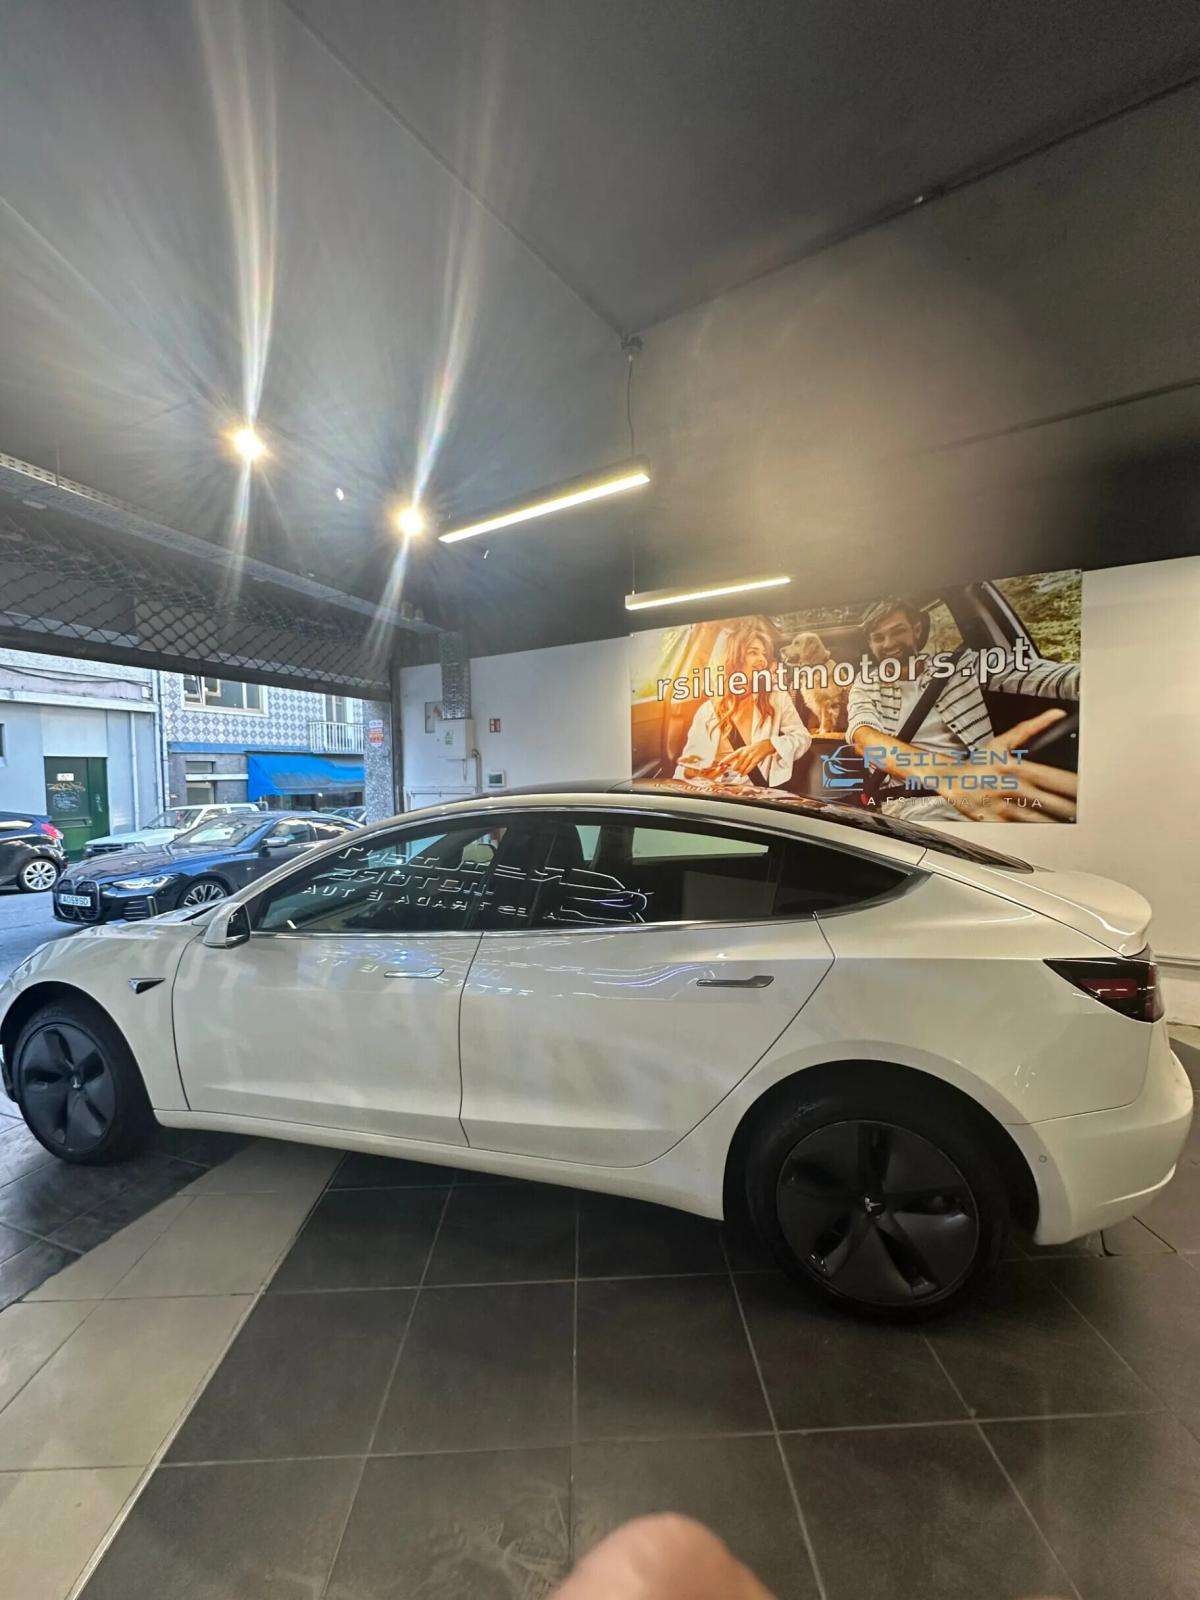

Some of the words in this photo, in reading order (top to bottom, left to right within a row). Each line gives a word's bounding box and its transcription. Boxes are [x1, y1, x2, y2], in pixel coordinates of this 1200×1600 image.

[656, 636, 1031, 701] rsilientmotors.pt
[867, 797, 876, 806] A
[1004, 797, 1042, 809] TUA
